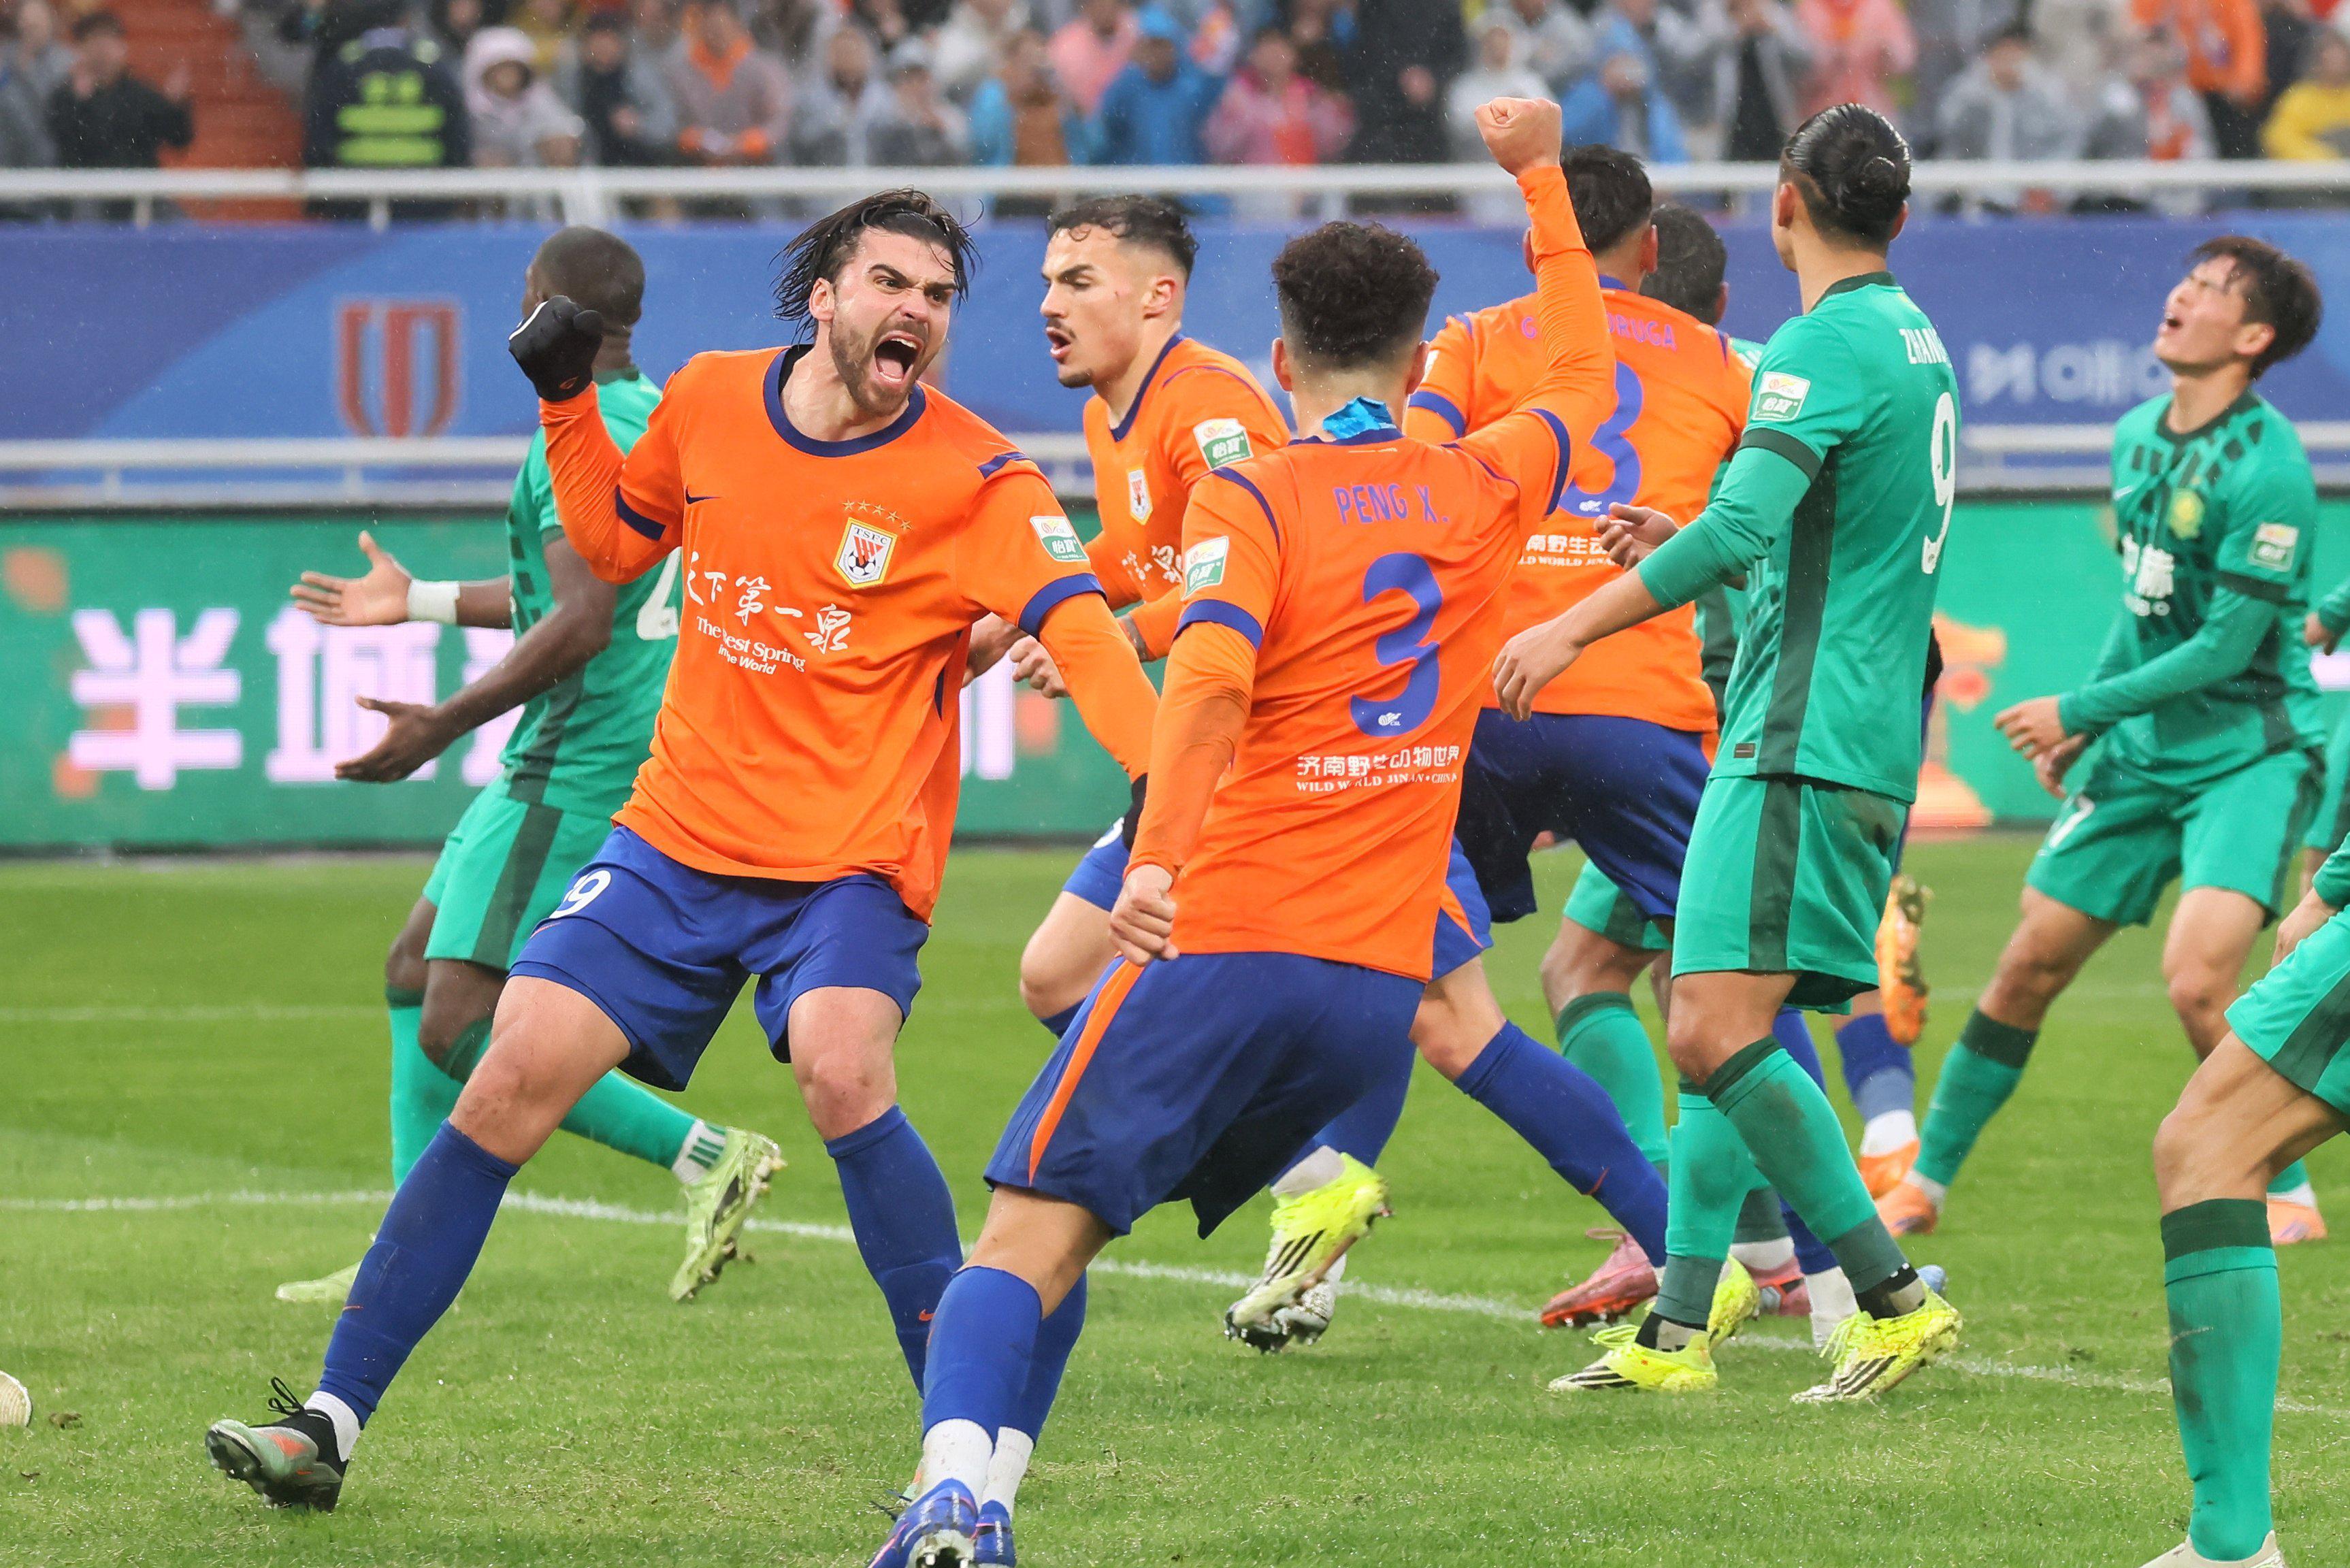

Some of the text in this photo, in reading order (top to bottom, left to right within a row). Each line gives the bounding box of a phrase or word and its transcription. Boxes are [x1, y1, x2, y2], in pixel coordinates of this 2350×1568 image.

[1921, 391, 1956, 574] 9
[1333, 483, 1449, 525] PENG X.
[854, 527, 888, 545] TSFC
[696, 615, 723, 639] The
[751, 642, 806, 673] Spring
[739, 655, 777, 675] World
[1349, 551, 1443, 737] 3
[1296, 781, 1334, 792] WILD
